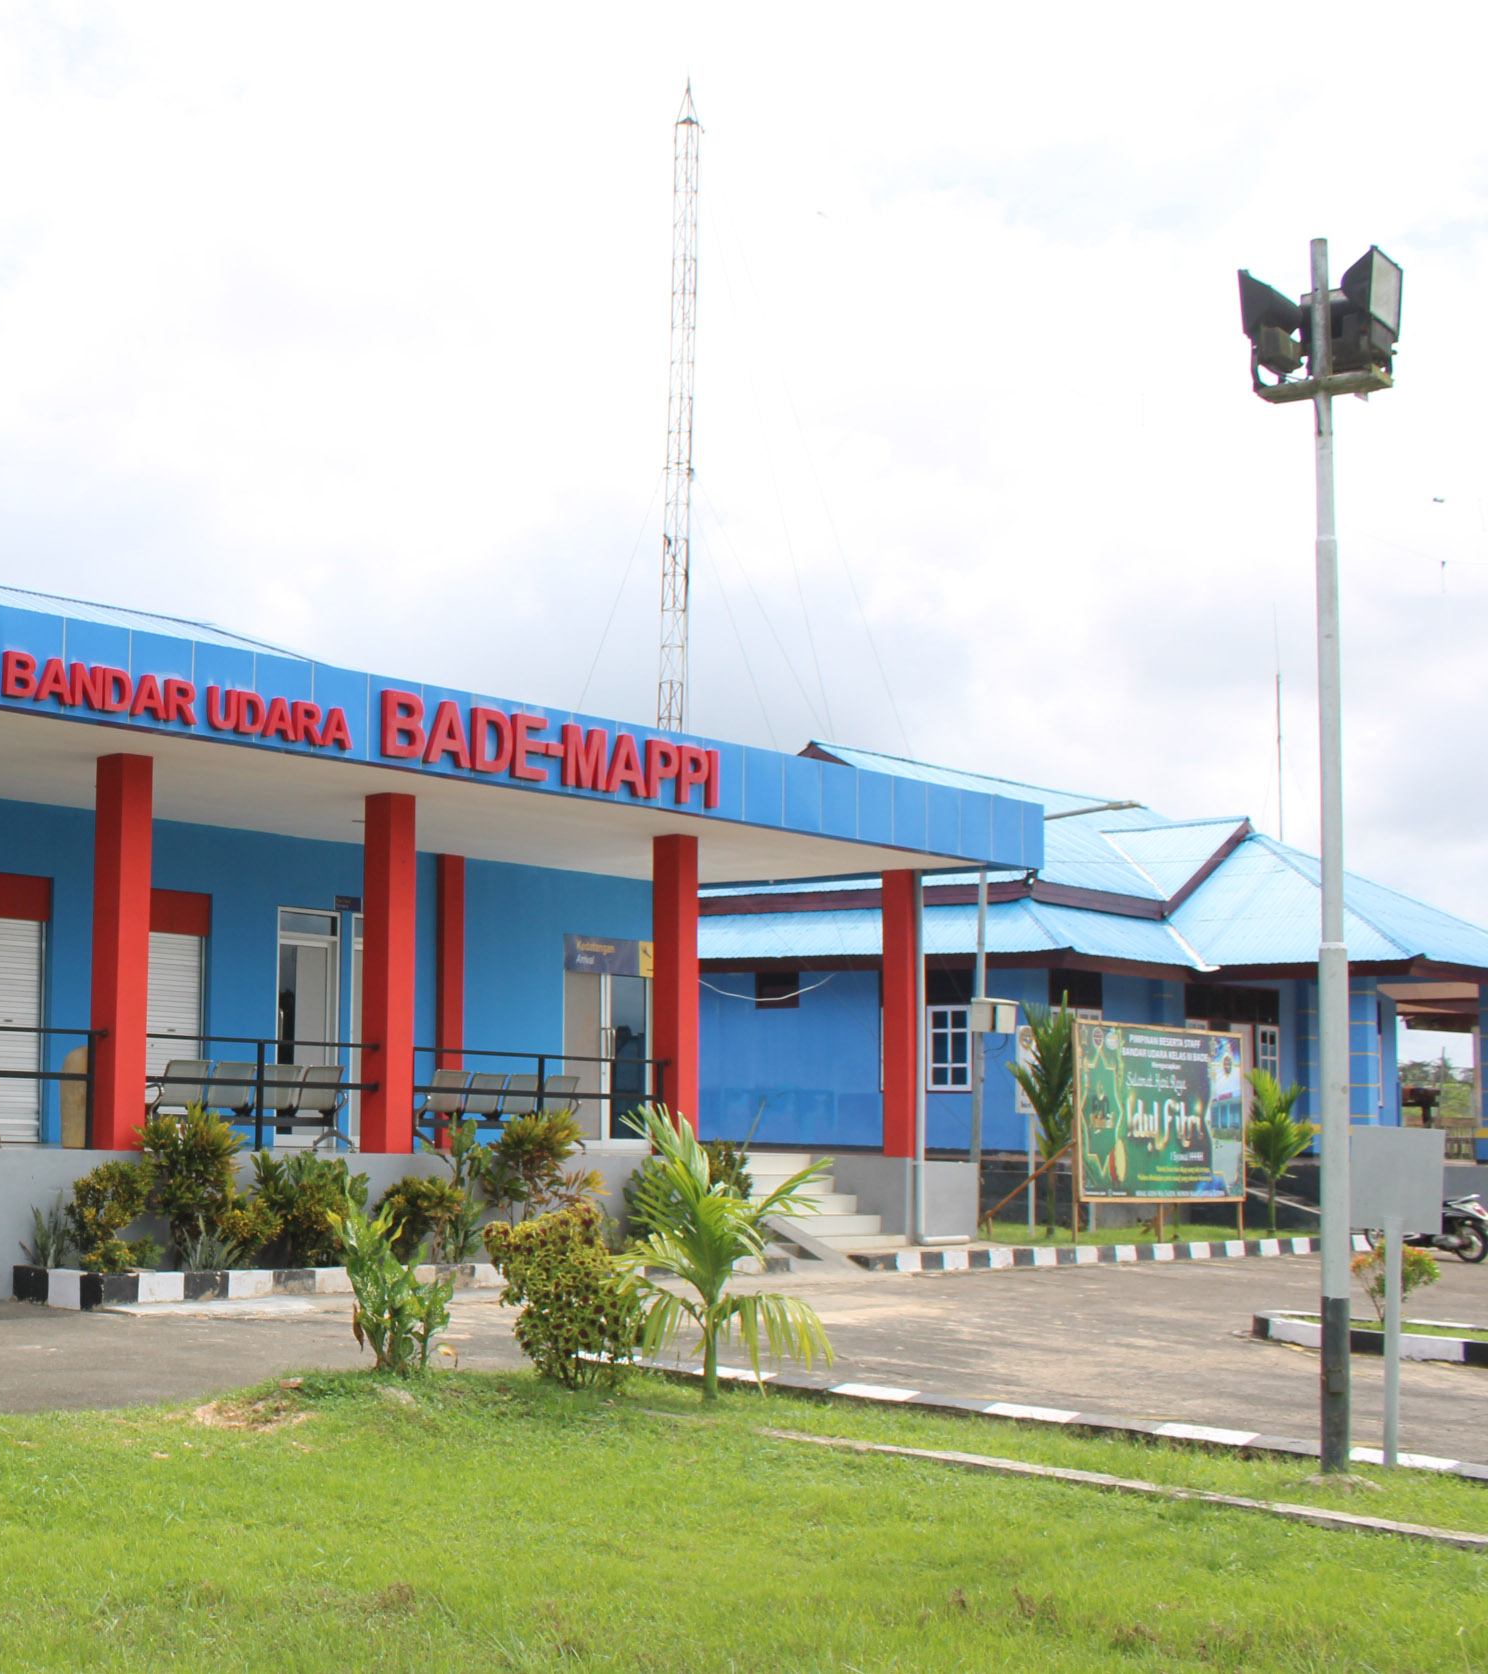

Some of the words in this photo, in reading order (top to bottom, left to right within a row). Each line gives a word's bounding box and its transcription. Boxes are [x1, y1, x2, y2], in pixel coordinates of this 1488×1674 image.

[1, 650, 198, 726] BANDAR
[206, 685, 354, 750] UDARA
[380, 688, 720, 808] BADE-MAPPI
